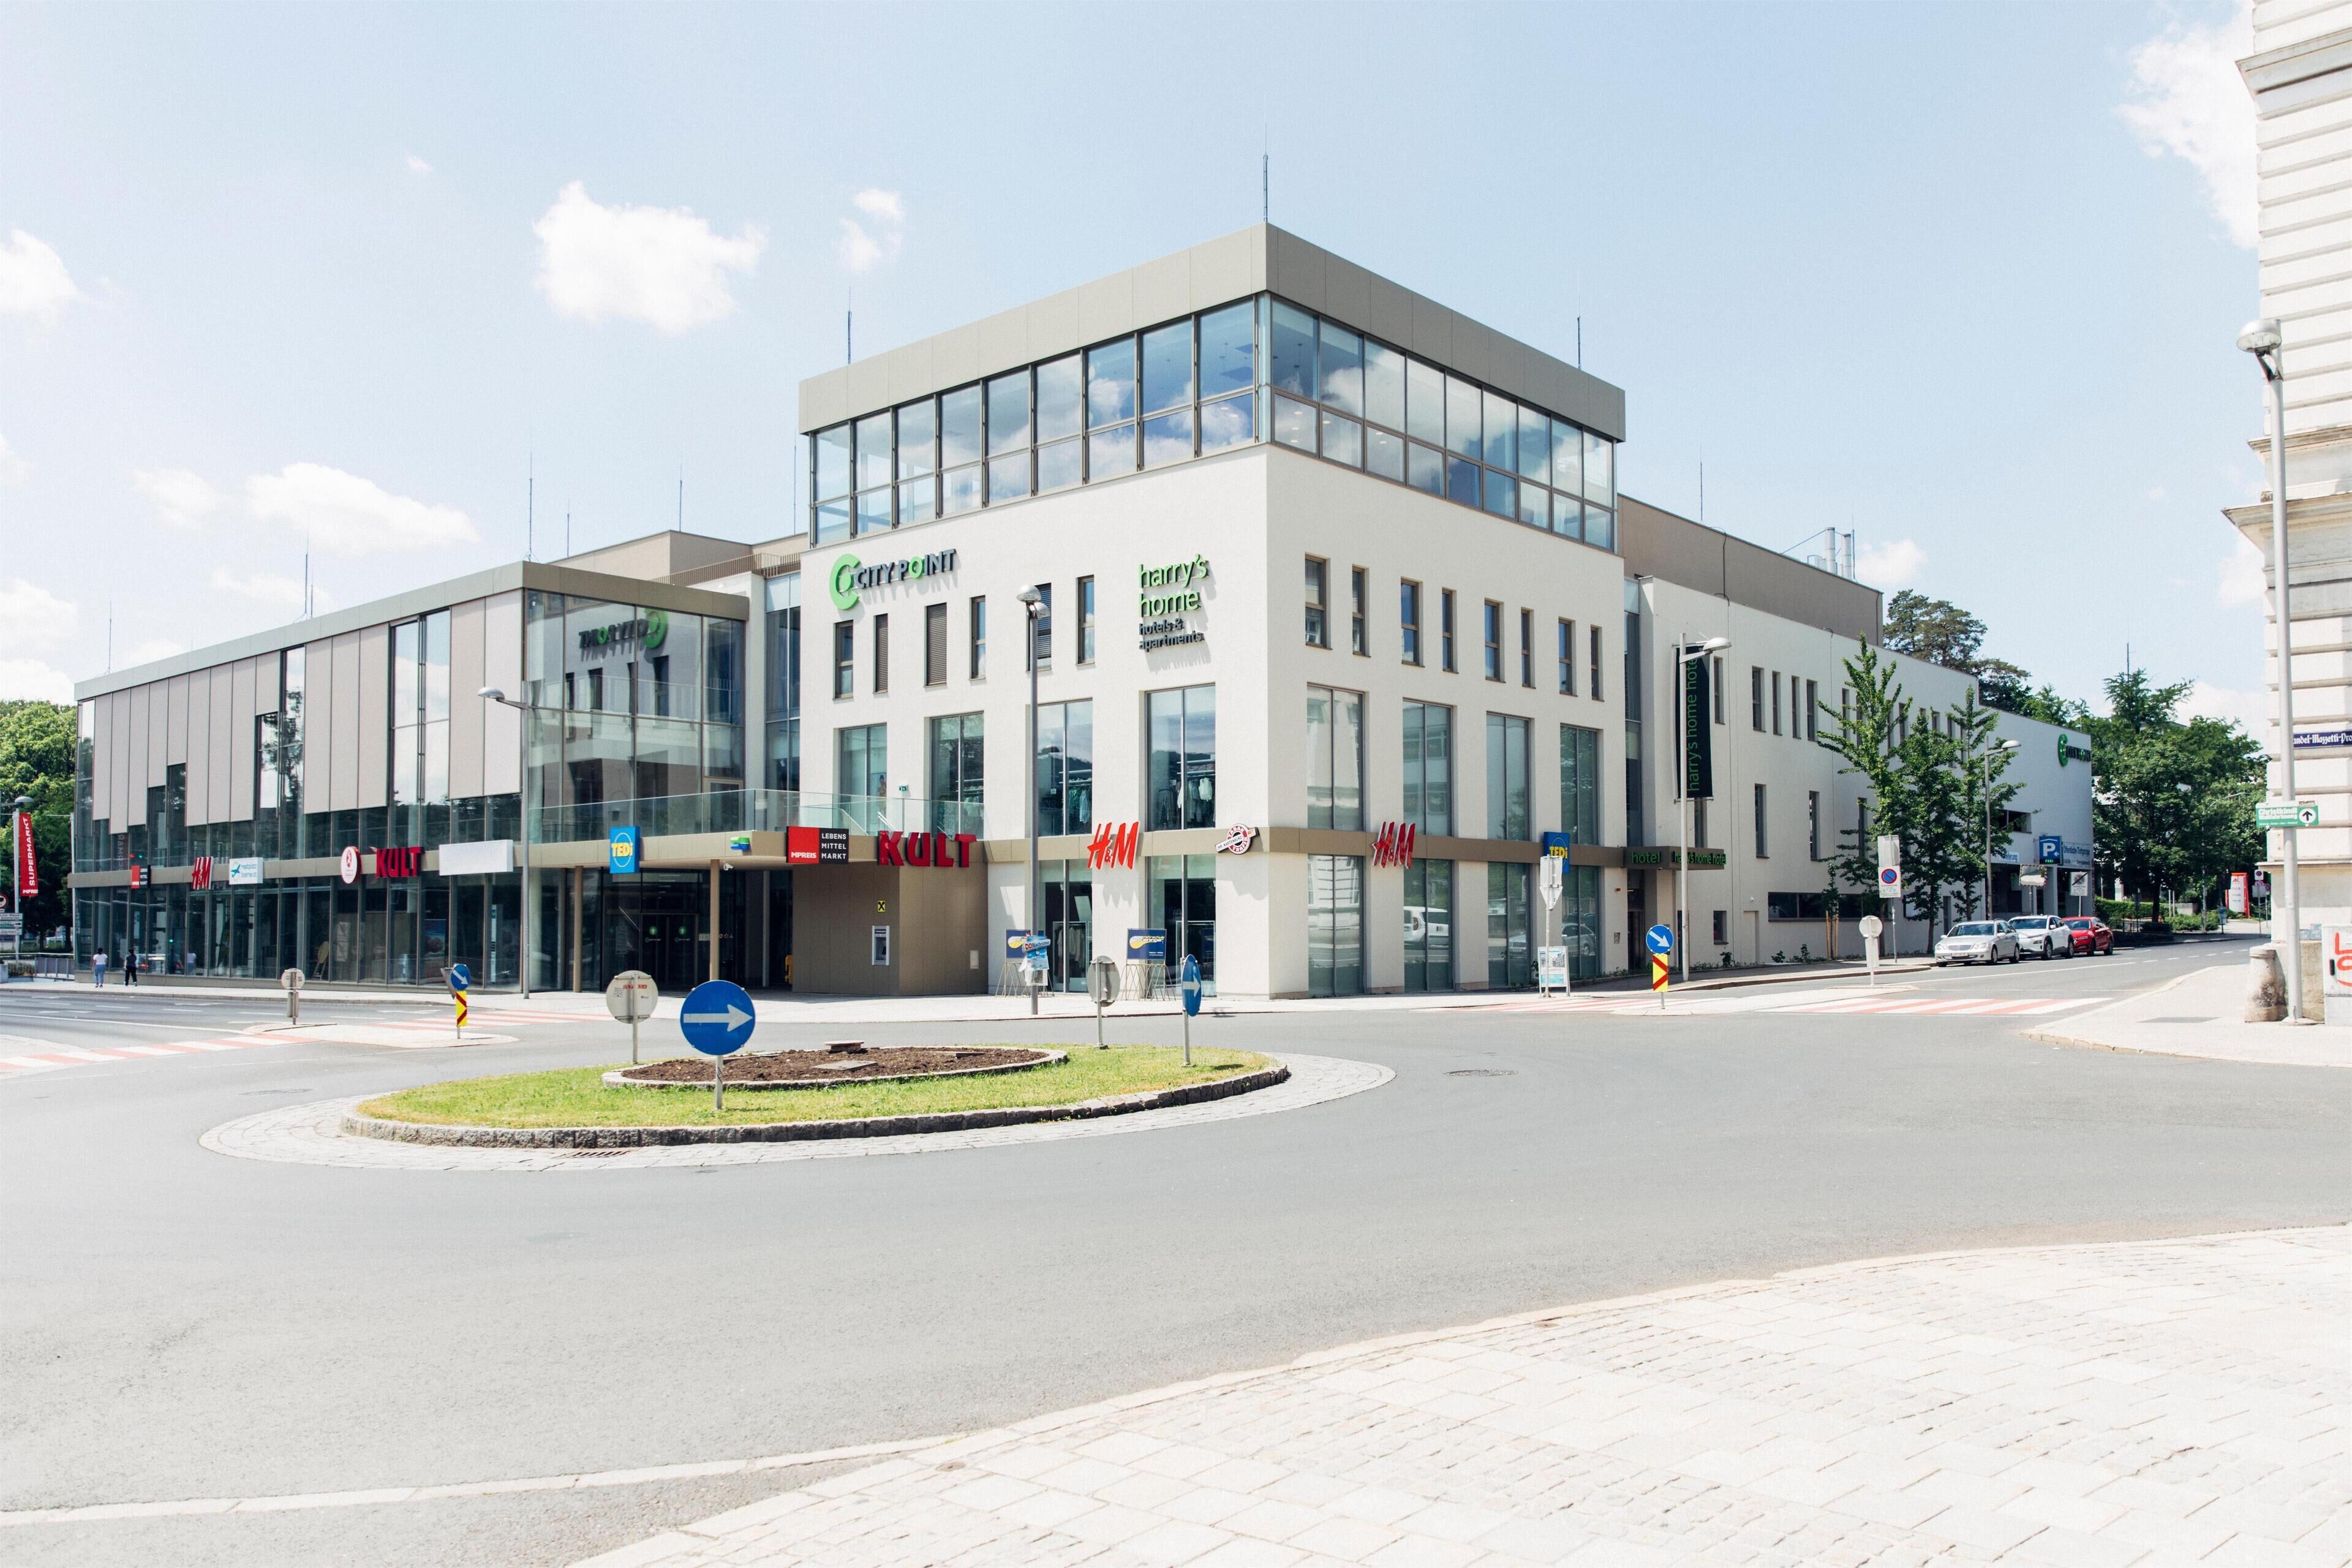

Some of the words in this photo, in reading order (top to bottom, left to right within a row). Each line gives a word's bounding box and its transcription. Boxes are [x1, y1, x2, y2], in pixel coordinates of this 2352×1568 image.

[856, 562, 894, 589] CITY
[898, 548, 956, 581] POINT
[1139, 554, 1210, 588] harry's
[1139, 590, 1201, 617] home
[1139, 619, 1173, 635] hotels
[1175, 617, 1185, 630] &
[1139, 631, 1205, 652] apartments
[1686, 657, 1697, 690] hote
[1687, 693, 1697, 737] home
[1686, 742, 1702, 791] harry's
[23, 817, 36, 886] SUPERMARKT
[611, 842, 633, 857] TEDi
[877, 831, 977, 867] KULT
[1087, 821, 1139, 870] H&M
[1372, 821, 1416, 869] H&M
[1549, 846, 1568, 859] TEDi
[1631, 852, 1661, 864] hotel
[1695, 852, 1711, 864] home
[1713, 853, 1727, 865] hotel
[2043, 843, 2056, 857] P
[192, 856, 213, 890] H&M
[376, 846, 422, 878] KULT
